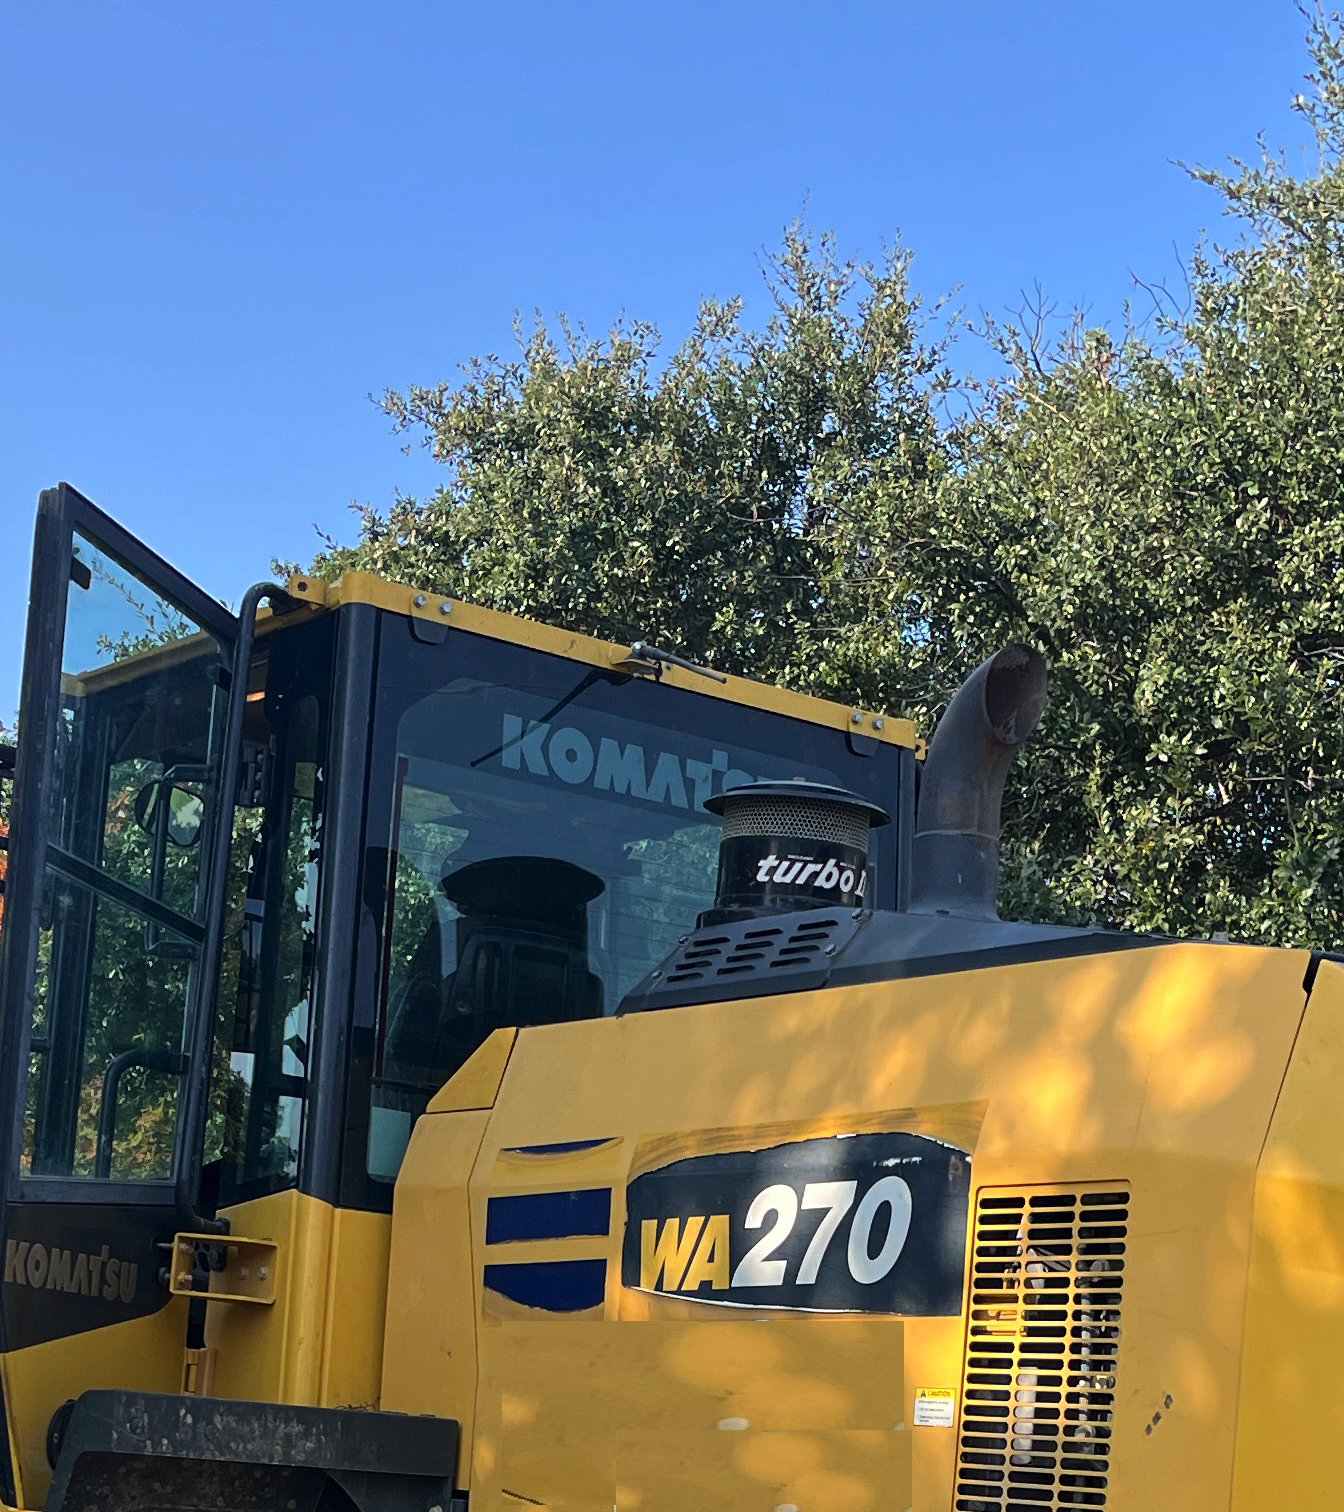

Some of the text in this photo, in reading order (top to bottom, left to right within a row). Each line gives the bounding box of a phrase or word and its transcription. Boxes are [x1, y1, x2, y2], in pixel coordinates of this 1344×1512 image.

[502, 713, 754, 814] KOMAT
[756, 854, 854, 893] turbo
[4, 1239, 139, 1304] KOMATSU
